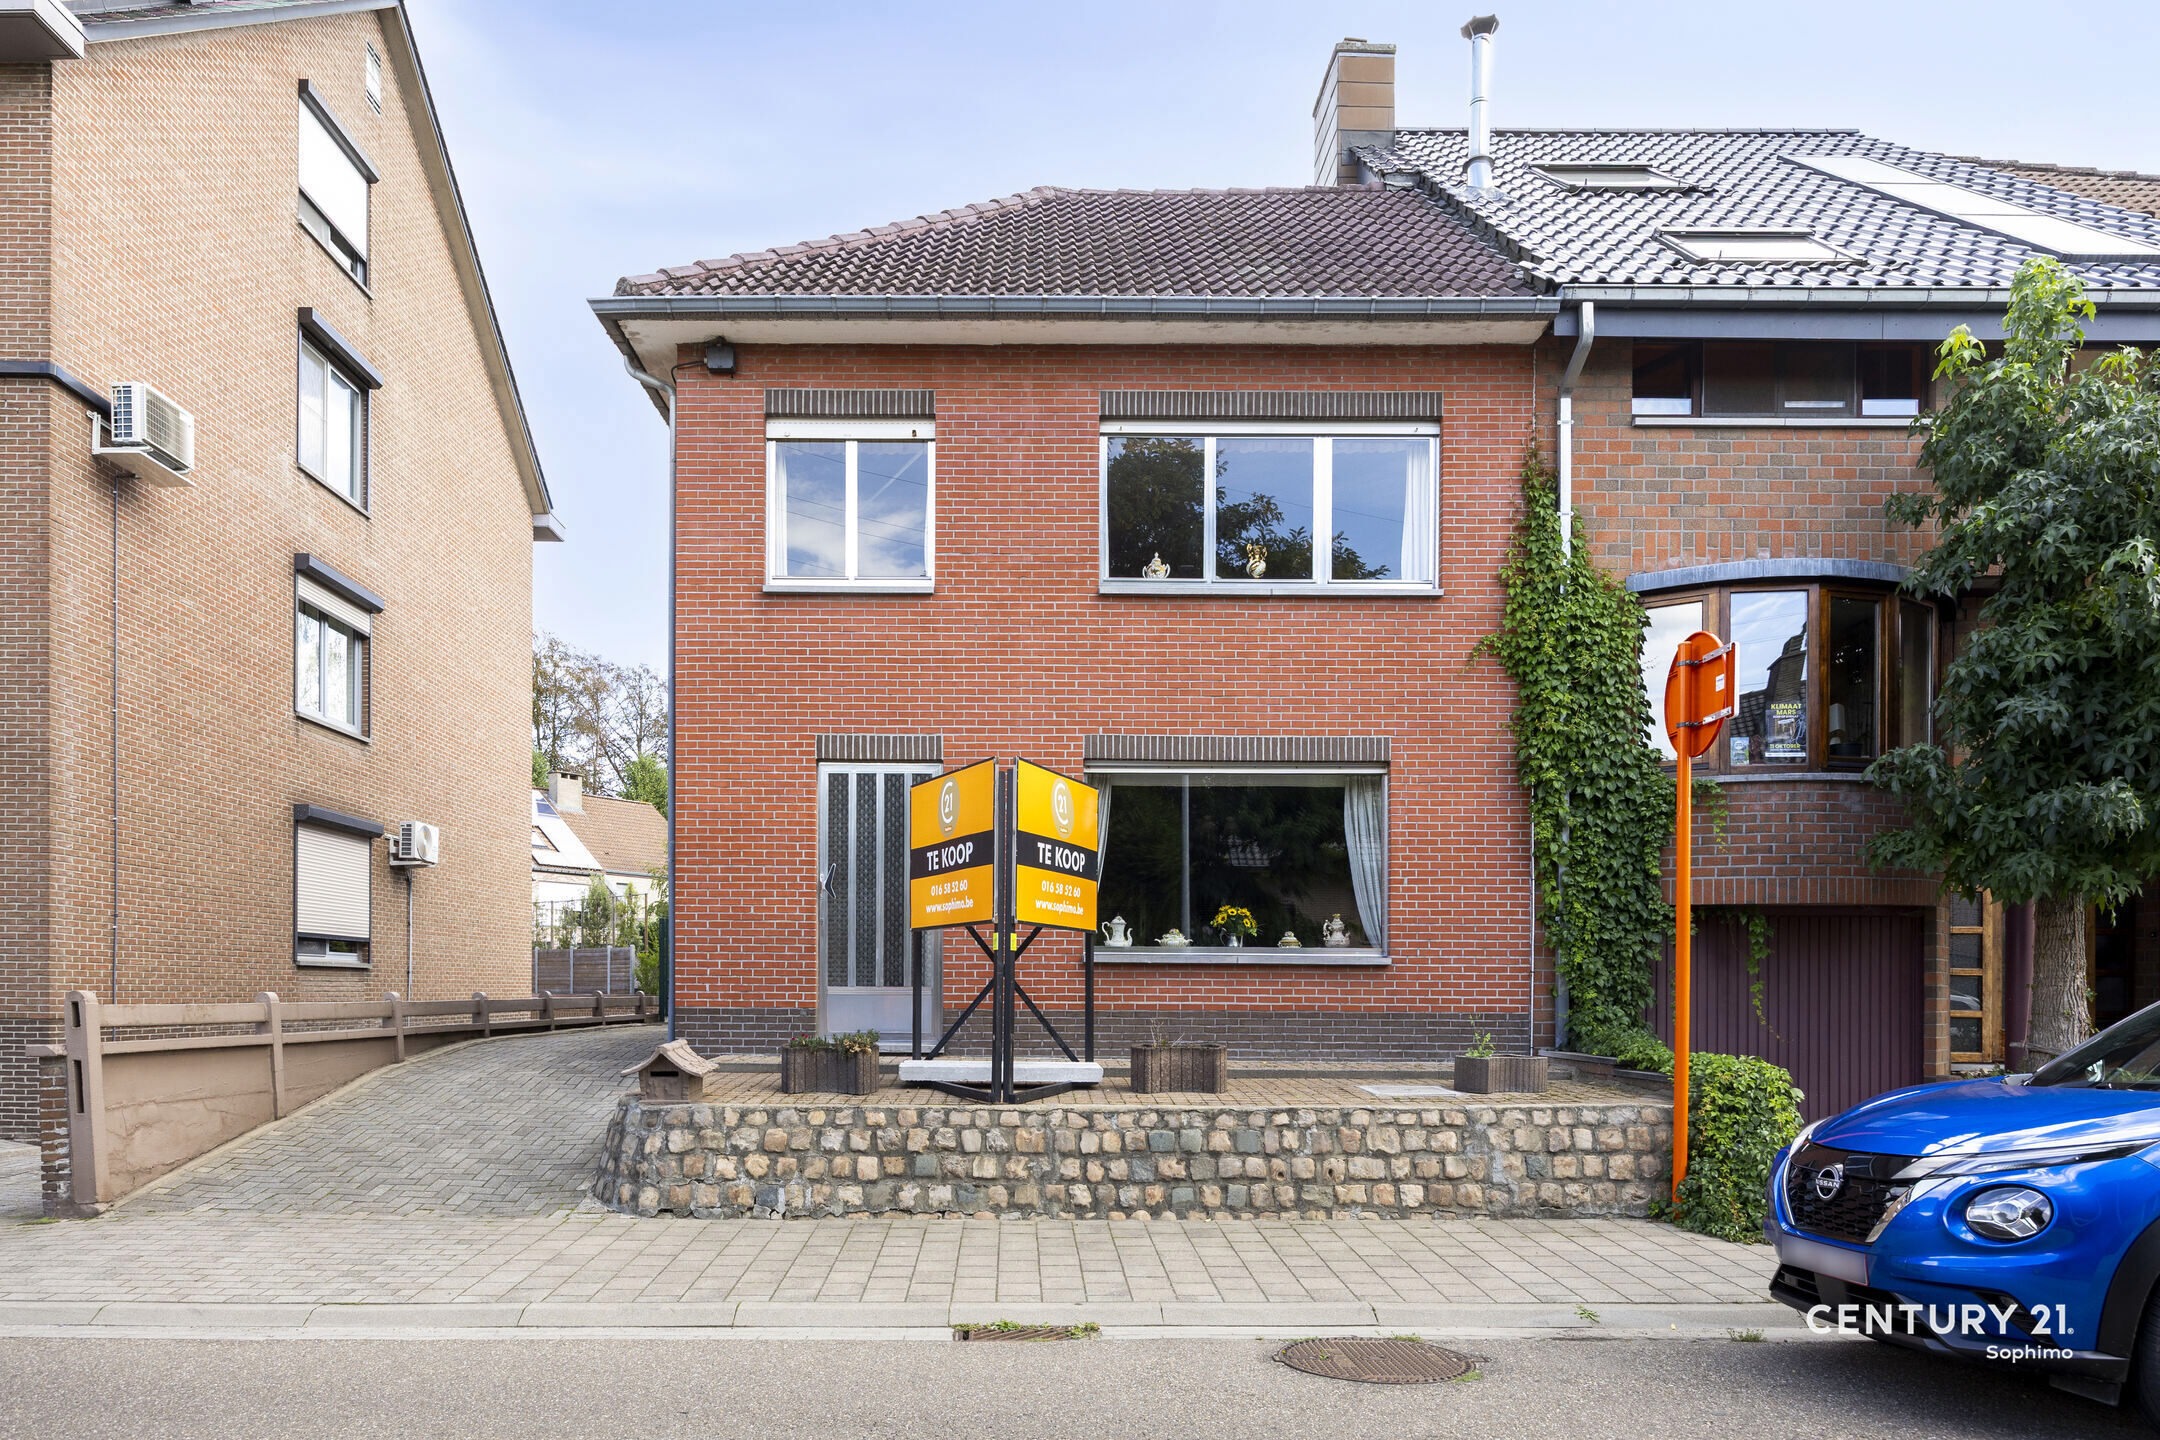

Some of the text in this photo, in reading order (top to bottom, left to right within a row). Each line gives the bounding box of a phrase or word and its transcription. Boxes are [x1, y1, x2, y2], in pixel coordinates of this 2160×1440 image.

[927, 841, 973, 871] TE KOOP
[1037, 842, 1085, 872] TE KOOP
[931, 880, 967, 896] 016 58 52 60
[1042, 880, 1080, 898] 016 58 52 60
[926, 896, 973, 914] www.sophimo.be
[1036, 900, 1083, 915] www.sophimo.be
